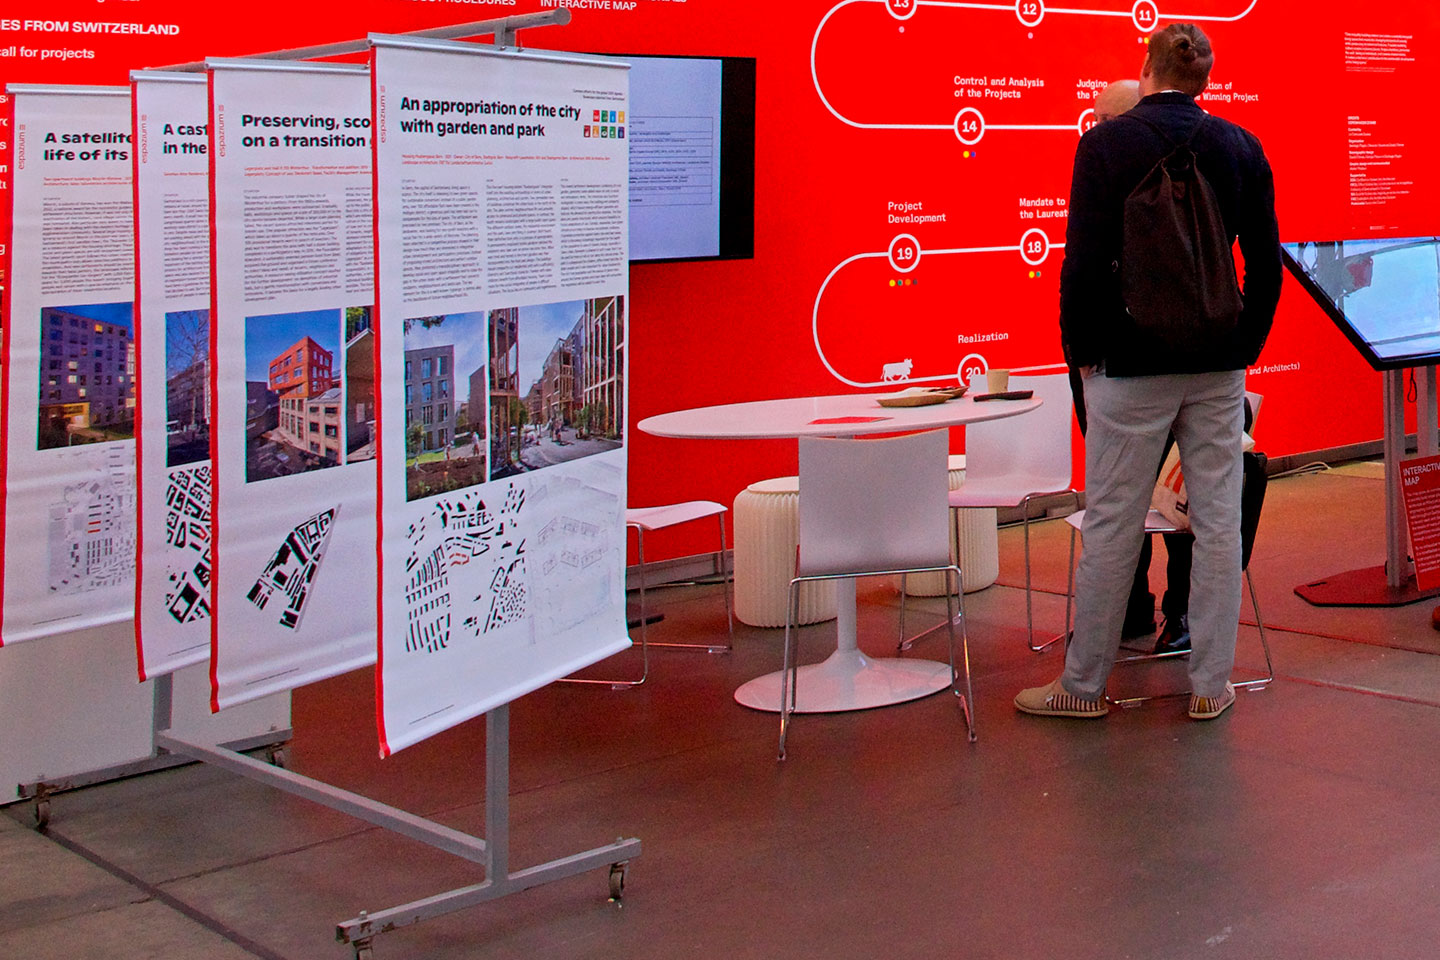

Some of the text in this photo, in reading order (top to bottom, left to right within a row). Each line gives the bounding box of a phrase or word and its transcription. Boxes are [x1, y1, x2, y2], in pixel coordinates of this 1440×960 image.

[613, 1, 637, 10] MAP
[1023, 4, 1036, 15] 12
[1140, 10, 1152, 21] 11
[954, 76, 1044, 89] Control and Analysis
[1077, 80, 1108, 90] Judging
[954, 88, 1021, 100] of the Projects
[402, 97, 581, 121] An appropriation of the city
[243, 115, 340, 130] Preserving,
[962, 121, 977, 132] 14
[401, 119, 545, 139] with garden and park
[243, 134, 366, 147] on a transition
[164, 142, 207, 154] in the
[45, 149, 128, 160] life of its
[888, 202, 922, 213] Project
[1020, 198, 1066, 206] Mandate to
[888, 212, 946, 224] Development
[1028, 241, 1042, 253] 18
[898, 248, 912, 260] 19
[958, 332, 1008, 344] Realization
[1405, 476, 1420, 486] MAP
